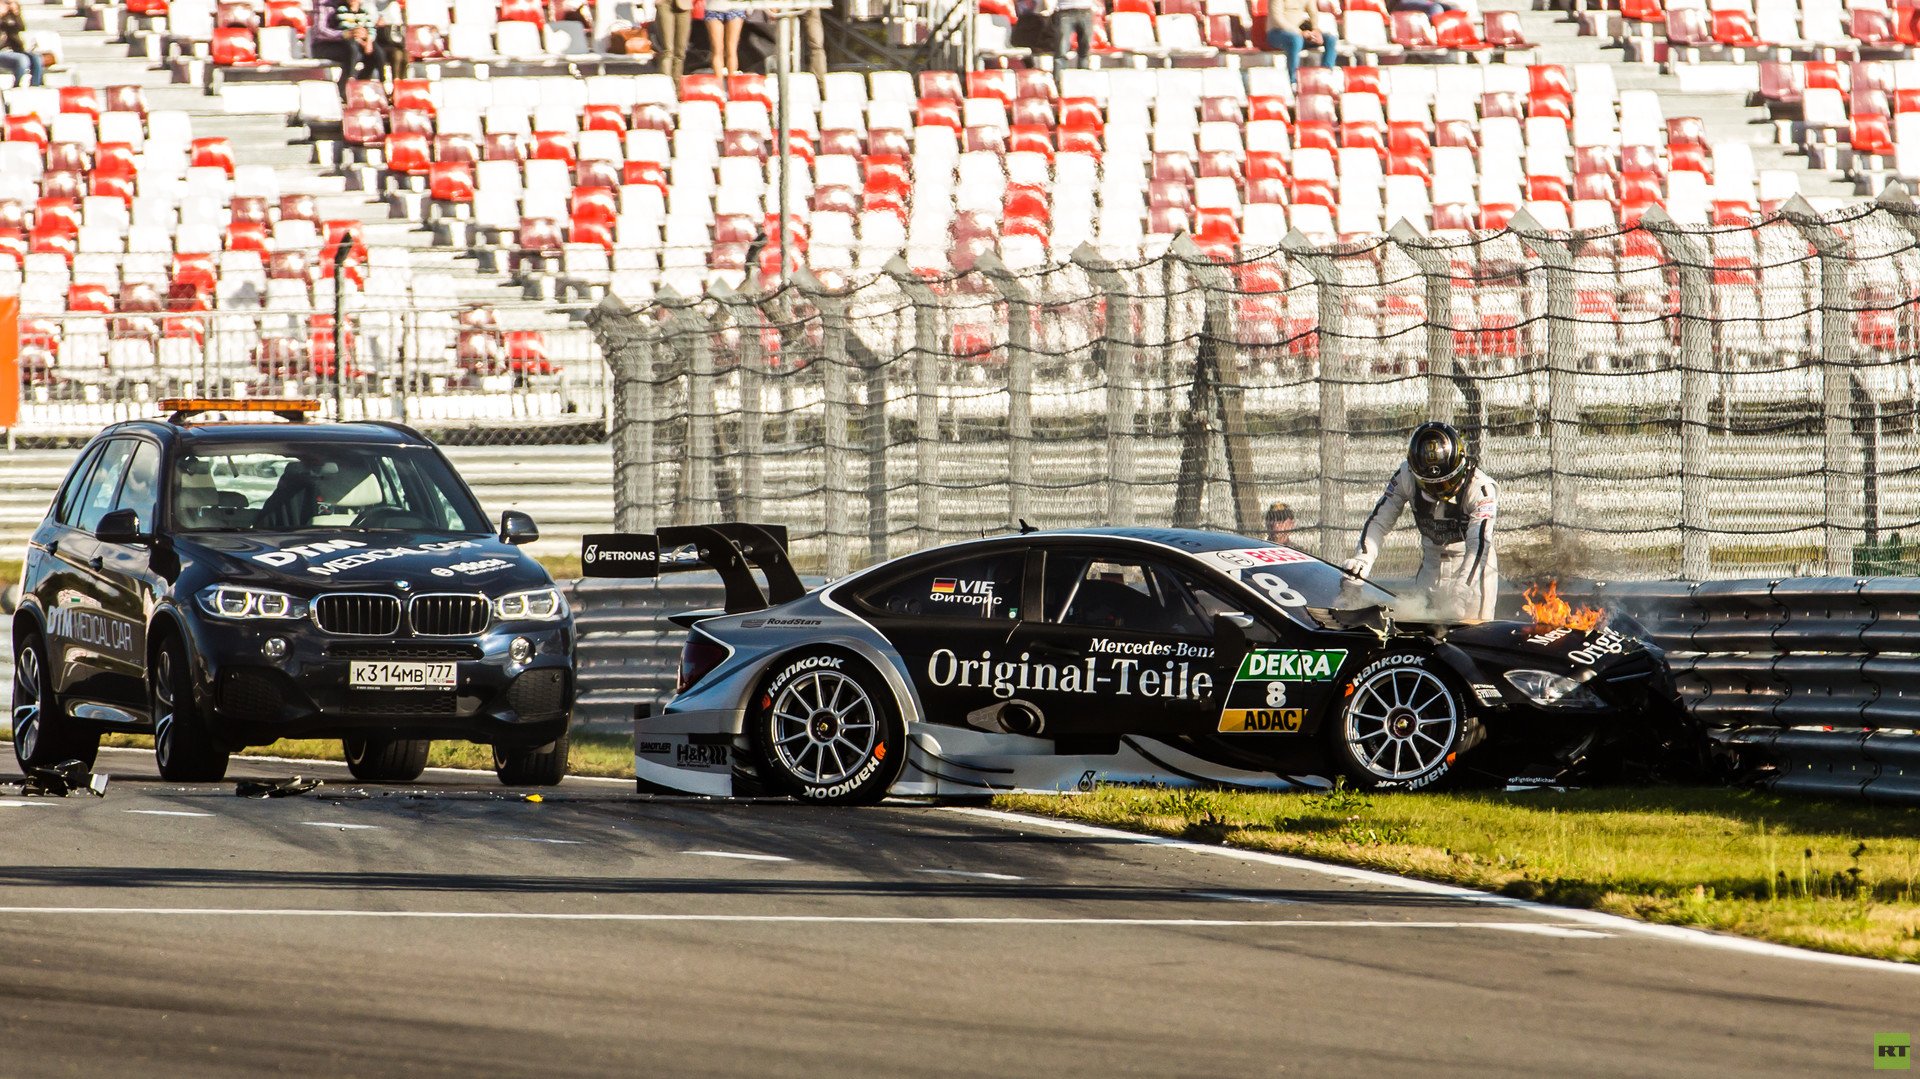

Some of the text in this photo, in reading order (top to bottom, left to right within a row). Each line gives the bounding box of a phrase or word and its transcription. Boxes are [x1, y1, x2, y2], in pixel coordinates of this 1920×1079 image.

[252, 539, 367, 567] DTM
[307, 540, 483, 576] MEDICAL CAR
[598, 551, 656, 561] PETRONAS
[960, 579, 996, 595] VIE
[1251, 572, 1308, 607] 8
[929, 592, 1003, 606] Фиторис
[46, 604, 133, 652] DTM MEDICAL CAR
[766, 618, 823, 626] RoadStars
[1088, 637, 1216, 658] Mercedes-Benz
[427, 664, 453, 679] 777
[927, 647, 1214, 700] Original-Teile
[1248, 653, 1332, 677] DEKRA
[1266, 681, 1287, 708] 8
[1243, 710, 1298, 731] ADAC
[677, 743, 709, 763] H&R
